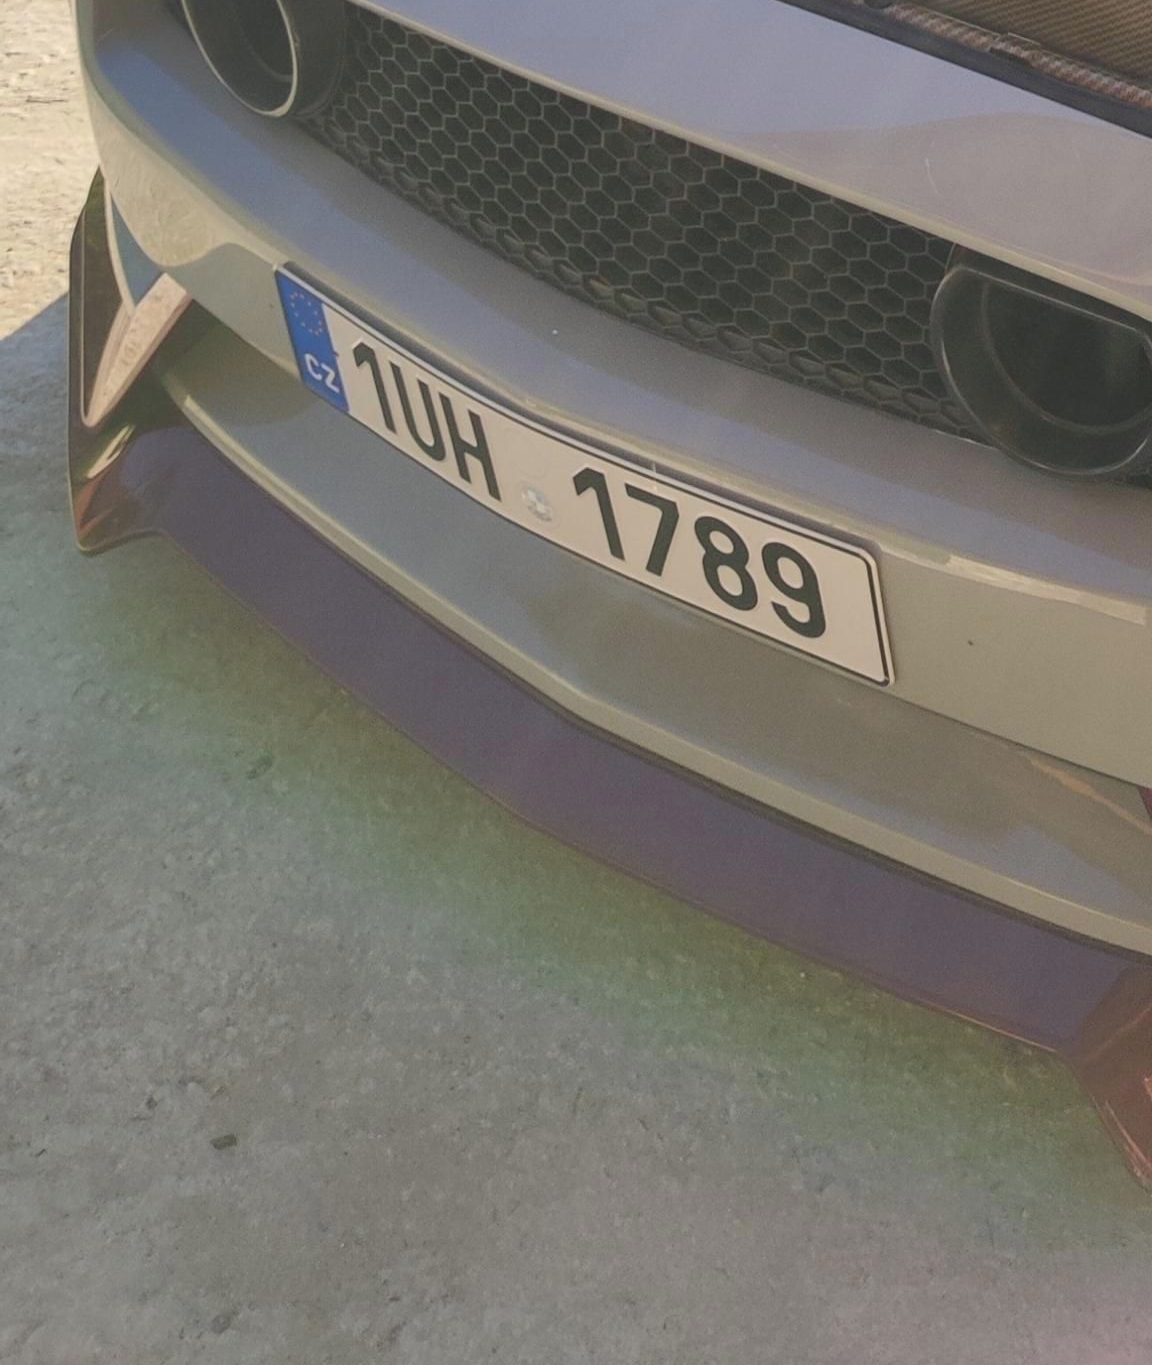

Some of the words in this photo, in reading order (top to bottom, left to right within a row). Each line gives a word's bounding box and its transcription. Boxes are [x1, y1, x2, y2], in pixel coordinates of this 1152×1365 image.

[305, 353, 341, 394] CZ
[353, 342, 502, 502] 1UH
[572, 467, 827, 639] 1789
